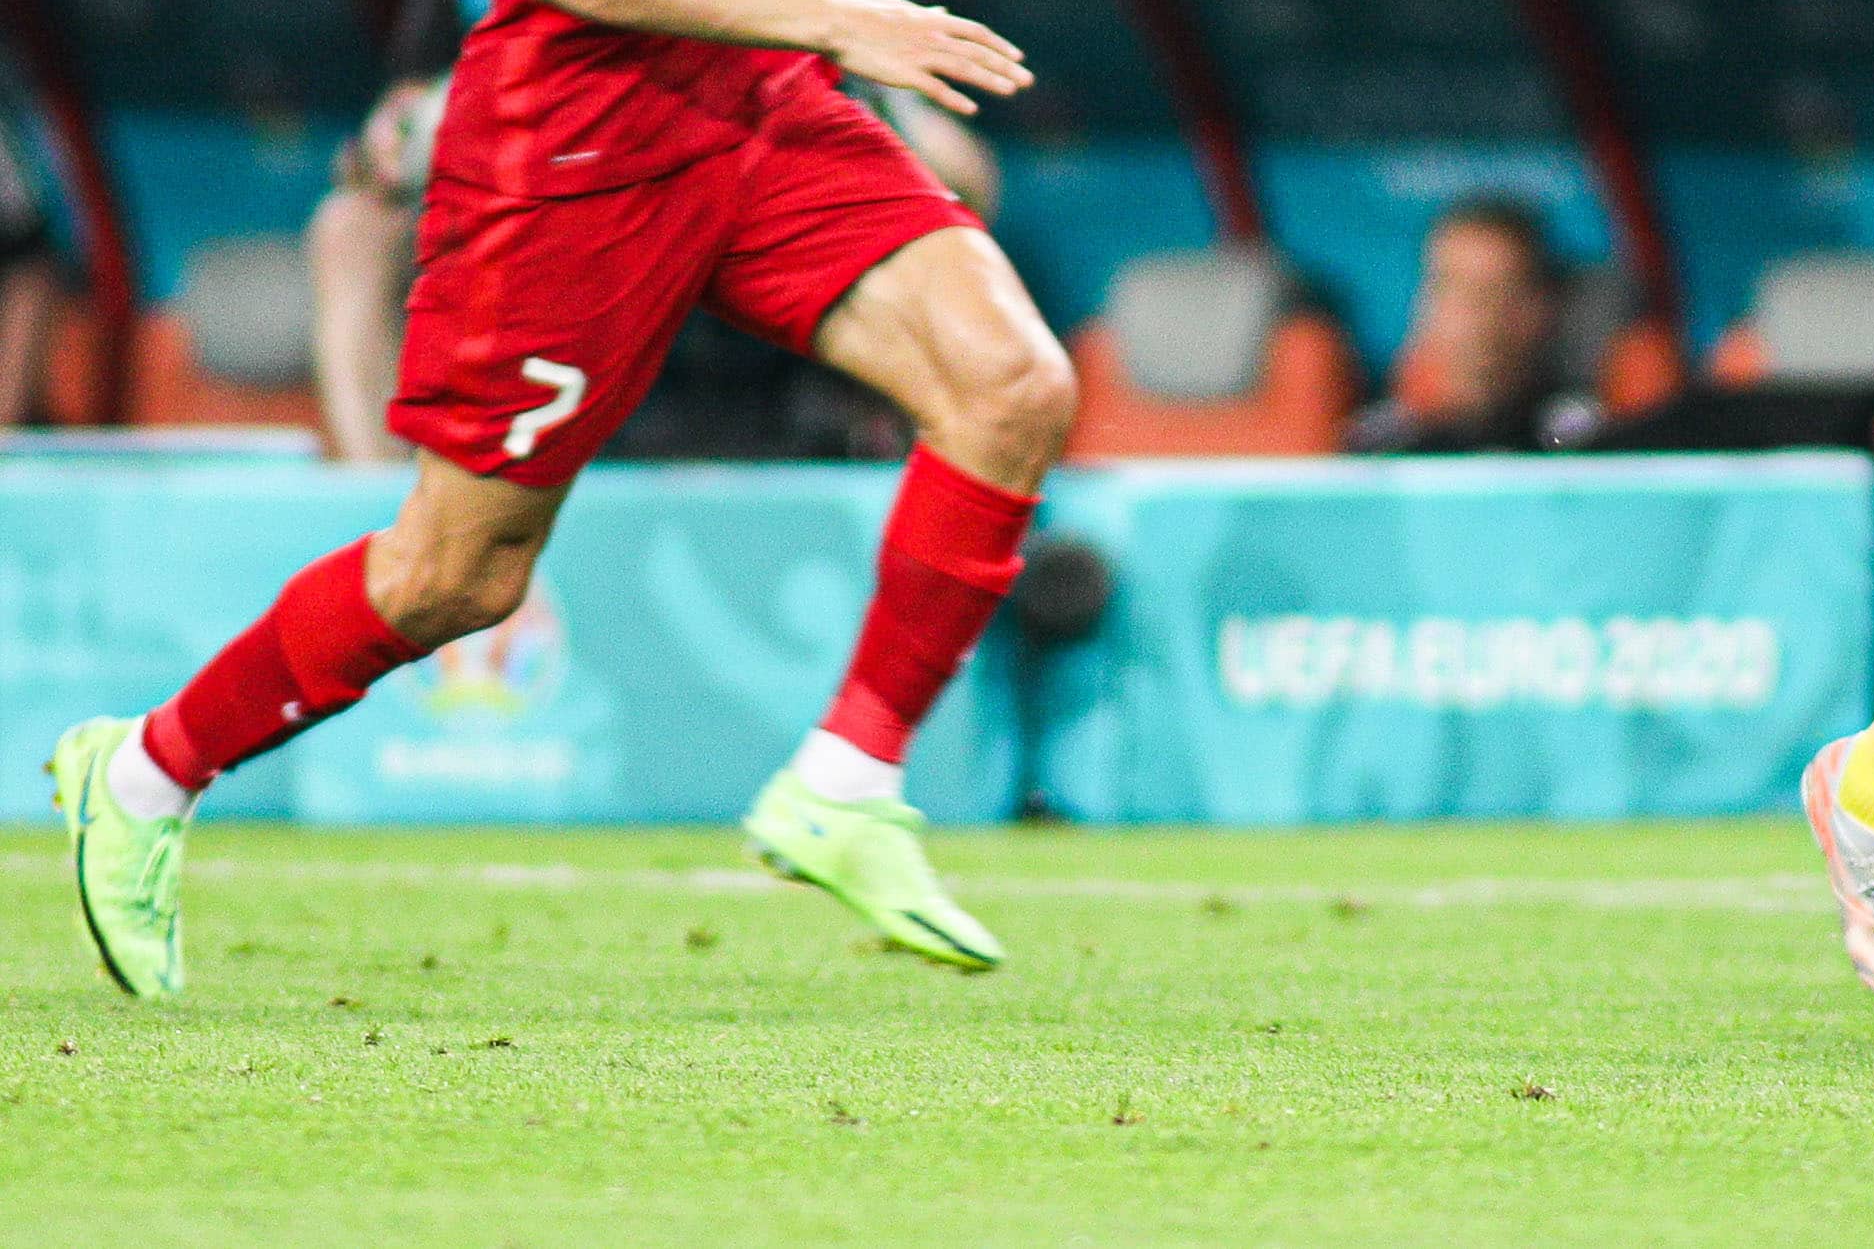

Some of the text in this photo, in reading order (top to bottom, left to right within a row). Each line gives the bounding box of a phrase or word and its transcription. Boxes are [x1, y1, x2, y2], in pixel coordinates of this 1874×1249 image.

[503, 356, 588, 458] 7
[1219, 614, 1778, 706] UEFA EURO 2020
